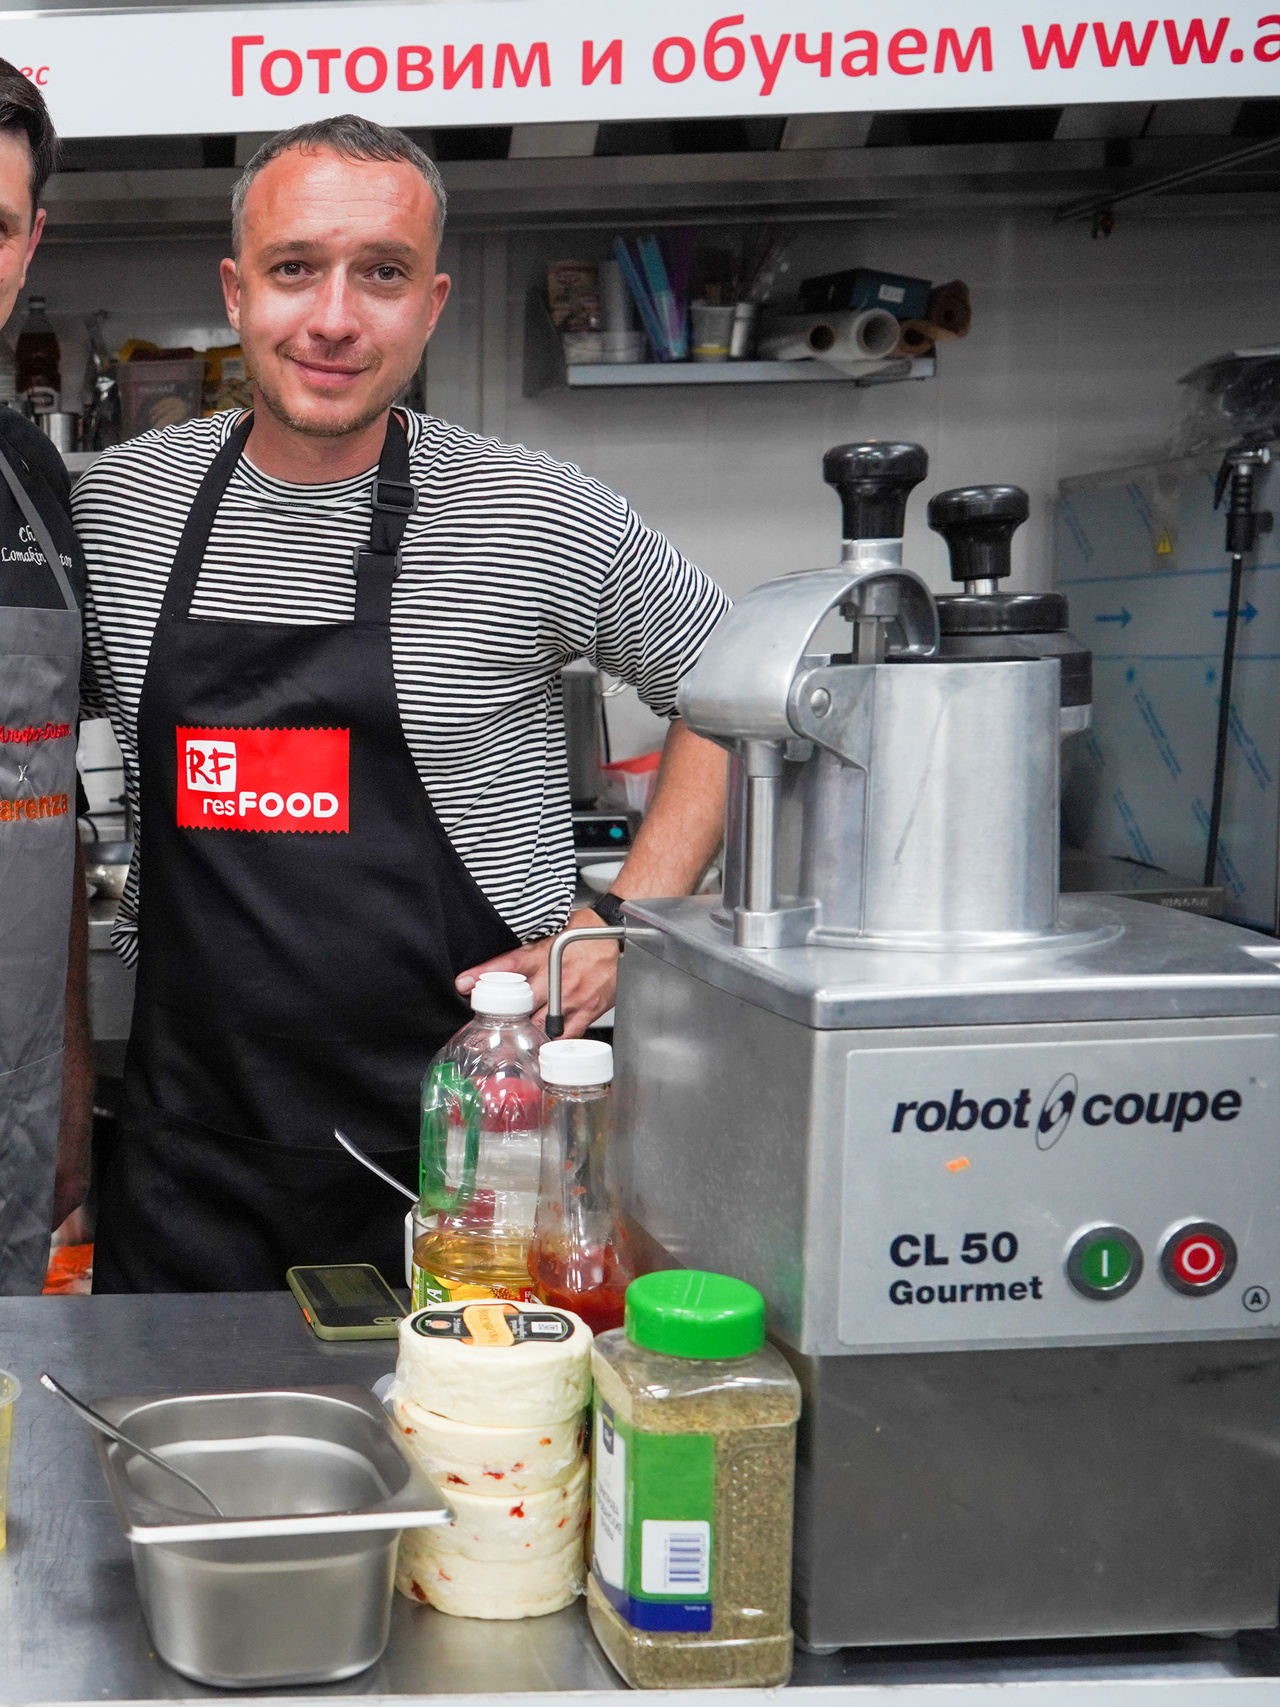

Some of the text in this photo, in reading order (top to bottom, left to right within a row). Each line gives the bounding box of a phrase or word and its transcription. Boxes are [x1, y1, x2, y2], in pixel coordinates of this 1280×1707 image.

[231, 35, 552, 97] Готовим
[581, 38, 623, 86] и
[652, 14, 993, 97] обучаем
[186, 746, 236, 787] RF
[891, 1087, 1243, 1133] robot coupe
[889, 1231, 1019, 1267] CL 50
[889, 1275, 1043, 1305] Gourmet
